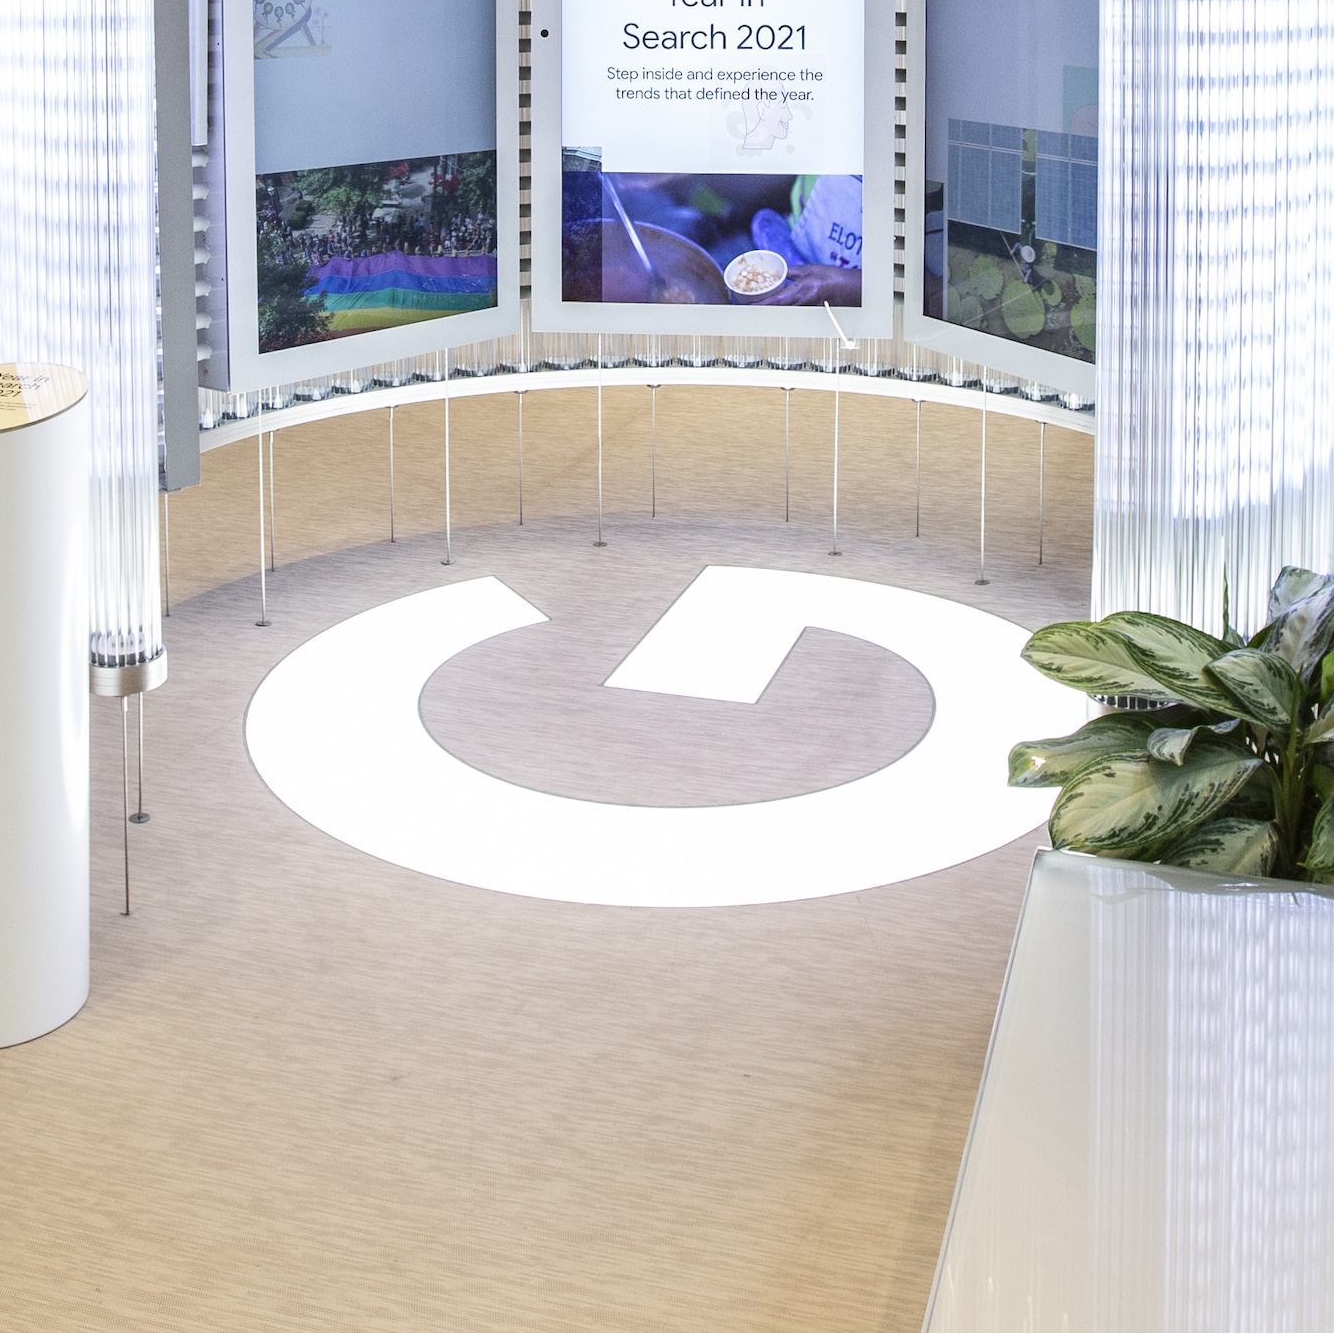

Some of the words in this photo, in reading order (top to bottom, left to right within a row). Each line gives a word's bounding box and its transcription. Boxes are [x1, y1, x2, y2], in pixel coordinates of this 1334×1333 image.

[623, 22, 727, 50] Search
[737, 24, 805, 50] 2021
[607, 66, 639, 83] Step
[642, 67, 683, 80] inside
[686, 68, 713, 80] and
[717, 68, 796, 84] experience
[800, 68, 823, 81] the
[615, 87, 660, 100] trends
[664, 87, 692, 100] that
[696, 87, 750, 101] defined
[754, 88, 778, 101] the
[781, 90, 814, 104] year.
